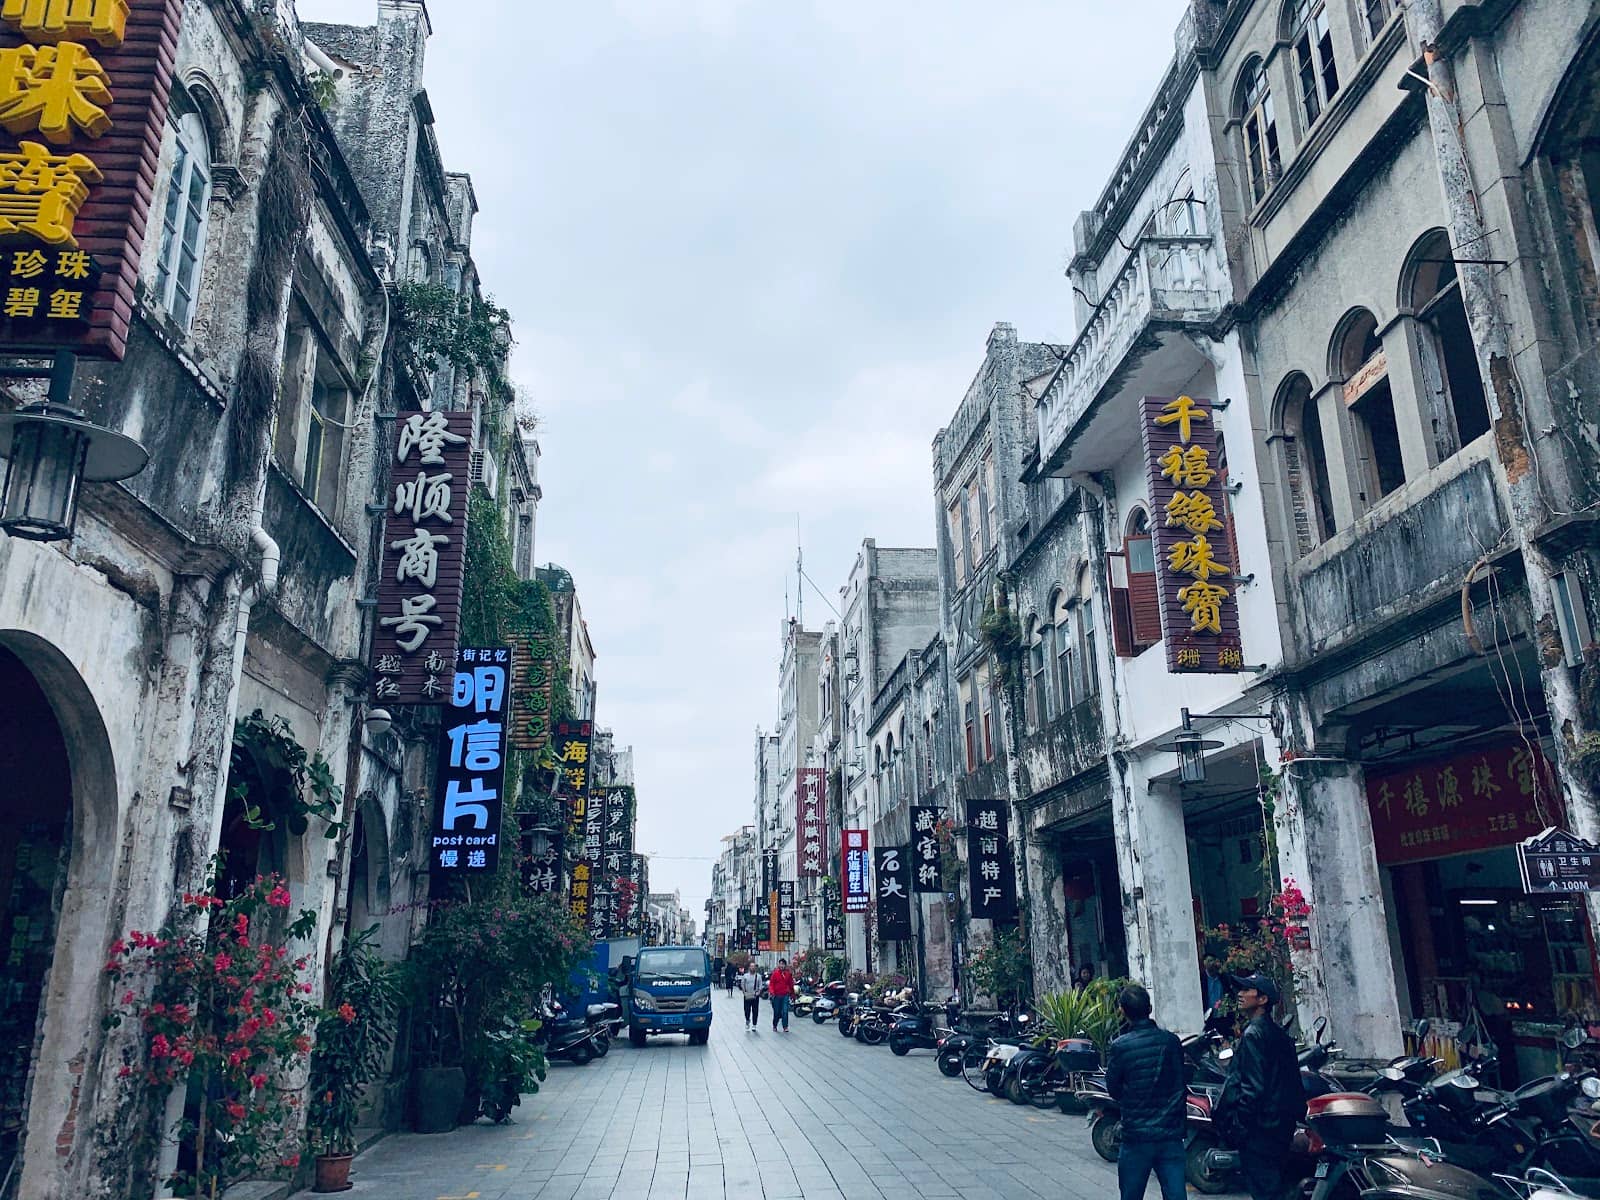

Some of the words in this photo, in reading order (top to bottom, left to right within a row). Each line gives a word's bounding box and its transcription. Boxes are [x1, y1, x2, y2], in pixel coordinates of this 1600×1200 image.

[10, 249, 91, 279] 珍珠
[3, 286, 84, 318] 碧玺
[380, 411, 467, 652] 隆顺商号
[455, 649, 508, 662] 街记忆
[443, 665, 506, 831] 明信片
[439, 849, 486, 868] 慢递
[914, 810, 940, 889] 藏宝轩
[978, 810, 1002, 907] 越南特产
[1558, 856, 1591, 867] 卫生间
[847, 850, 862, 894] 北海鲜生
[1562, 881, 1590, 891] 100M
